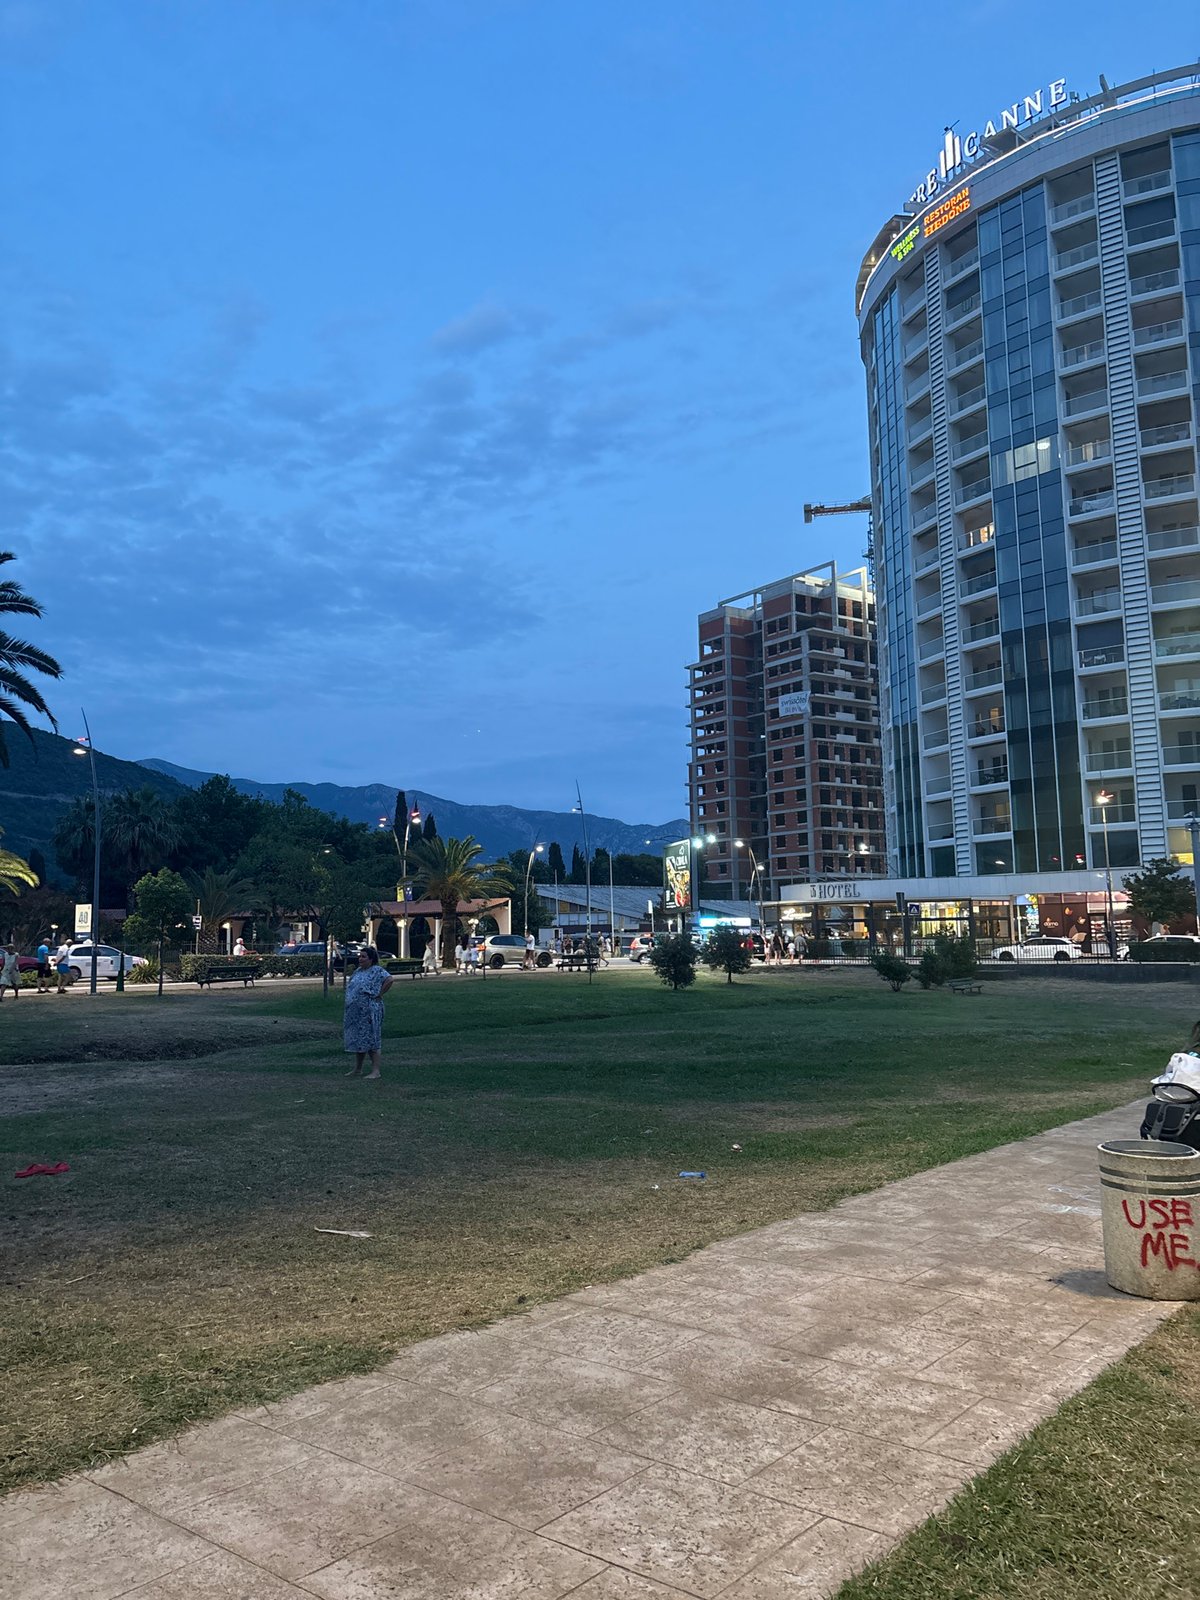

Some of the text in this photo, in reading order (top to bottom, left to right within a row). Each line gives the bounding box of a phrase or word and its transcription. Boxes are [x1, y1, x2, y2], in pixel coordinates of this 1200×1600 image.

[964, 78, 1067, 157] CANNE
[923, 187, 969, 226] RESTORAN
[923, 198, 970, 238] HEDONE
[819, 883, 861, 899] HOTEL
[1121, 1198, 1195, 1230] USE
